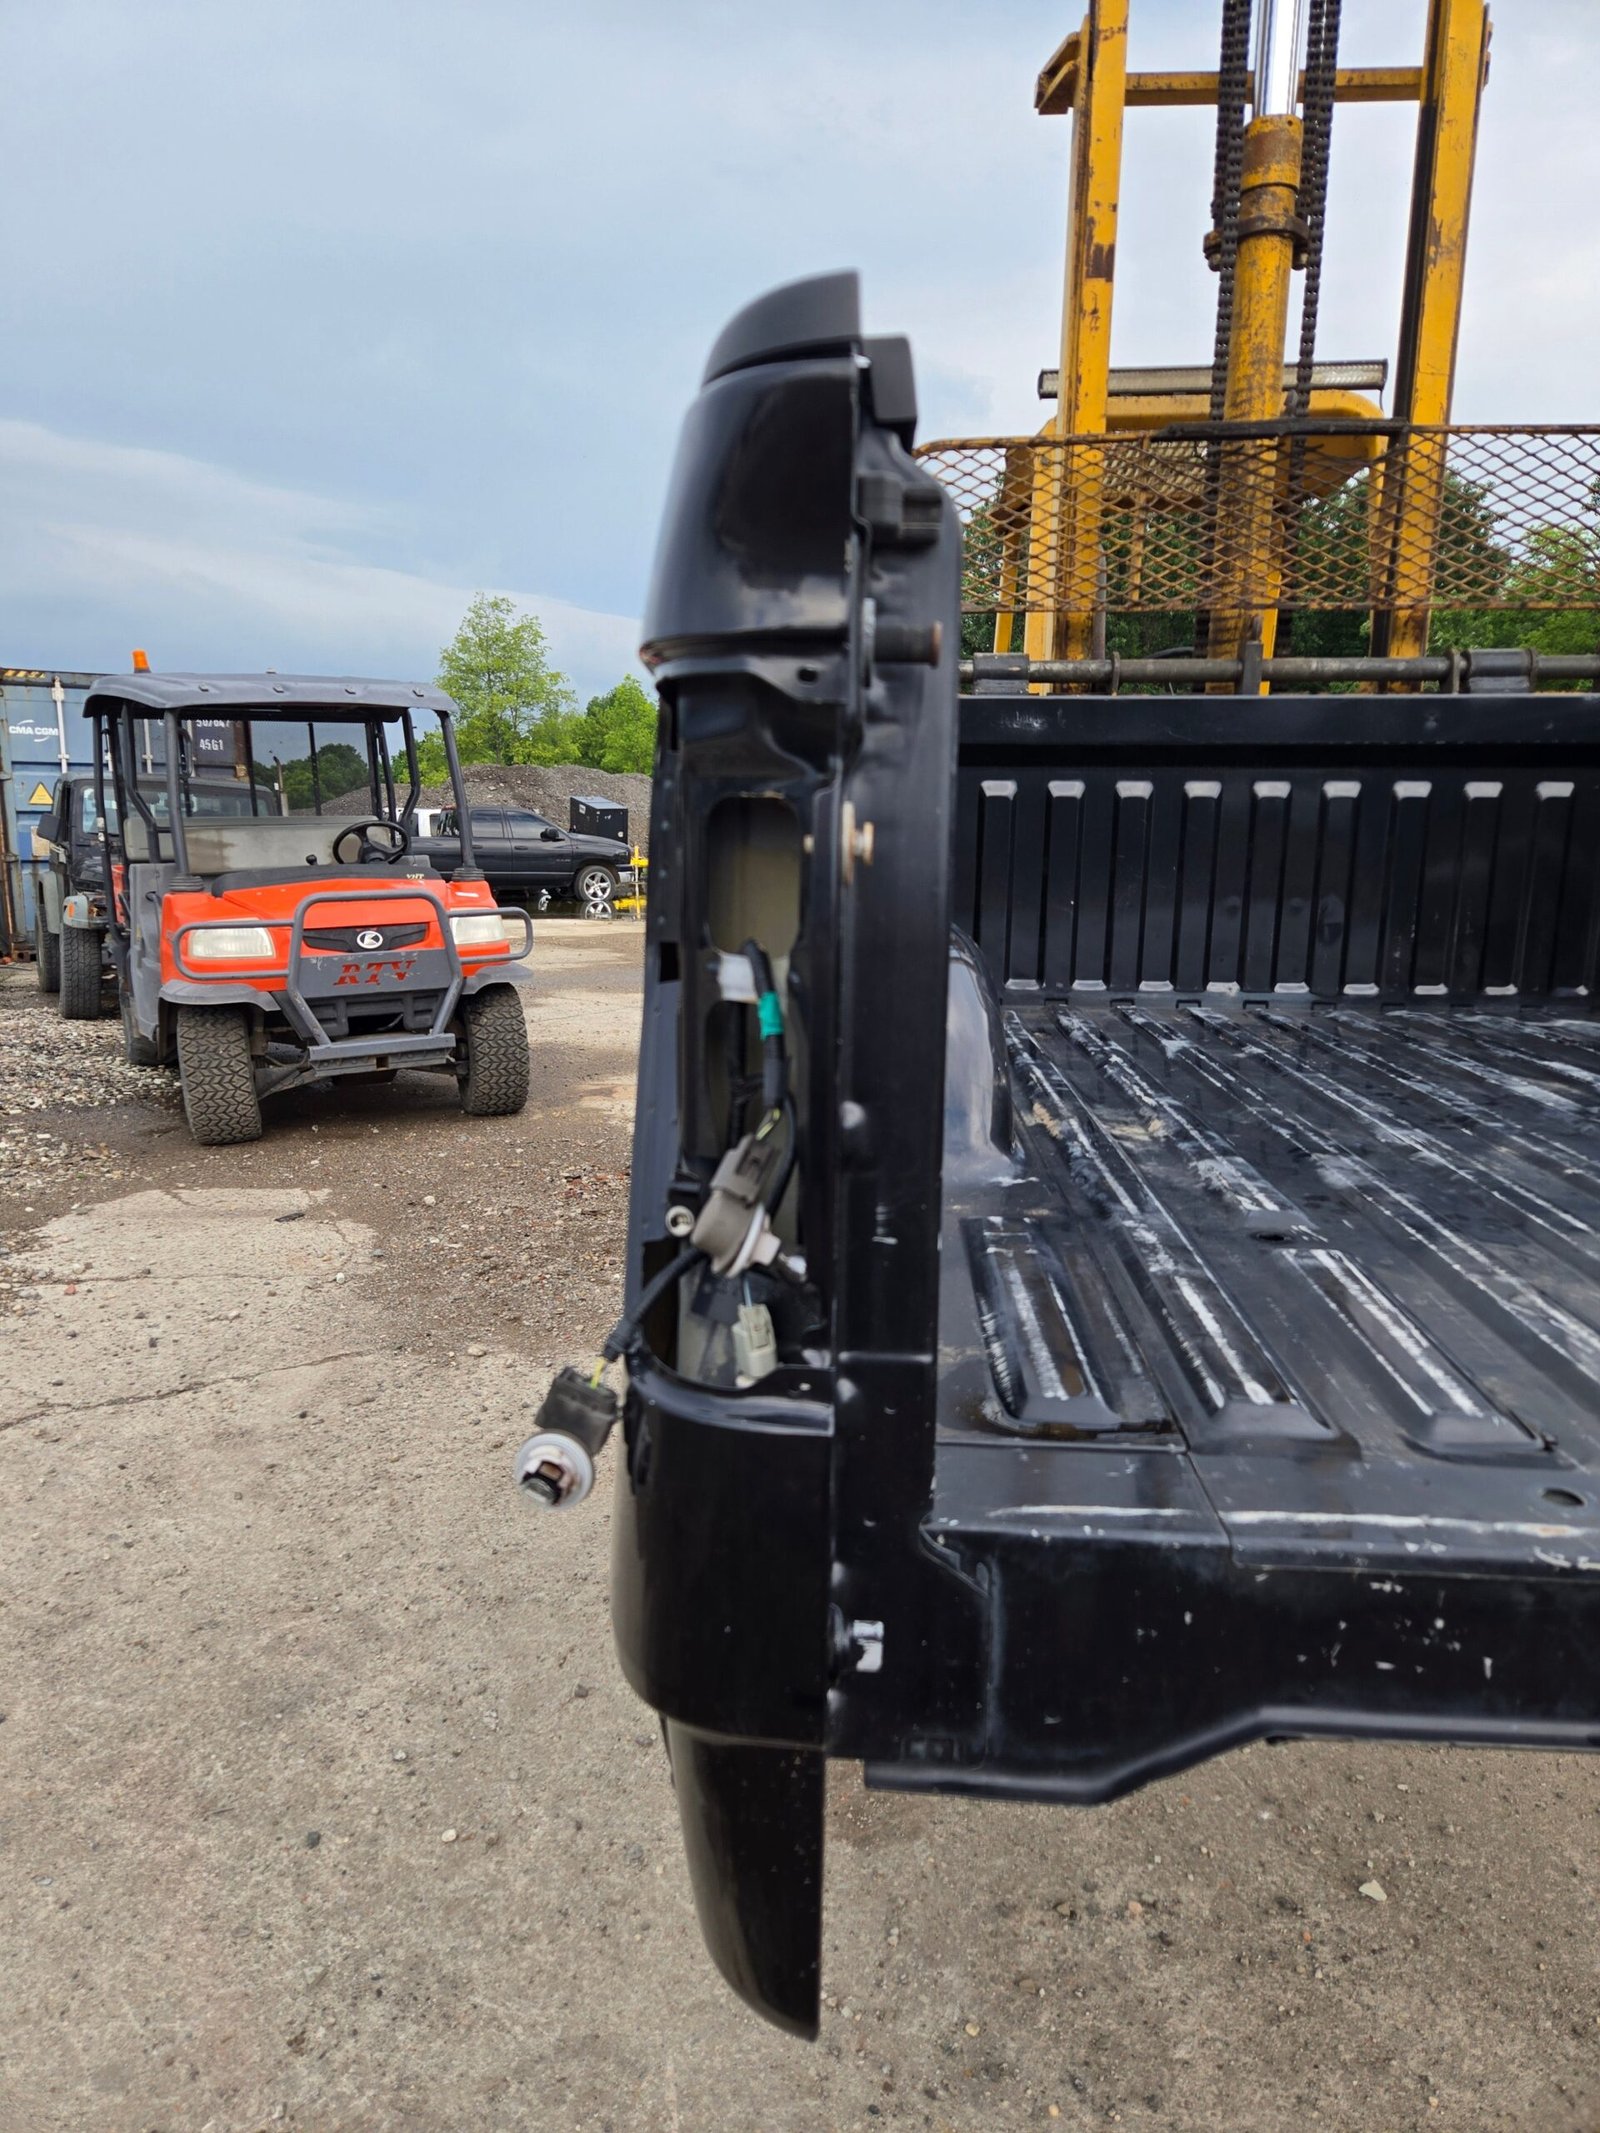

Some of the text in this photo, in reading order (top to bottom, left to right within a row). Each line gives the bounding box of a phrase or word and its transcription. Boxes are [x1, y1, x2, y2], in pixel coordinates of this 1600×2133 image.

[9, 726, 59, 736] CMA CGM
[332, 960, 416, 986] RTV
